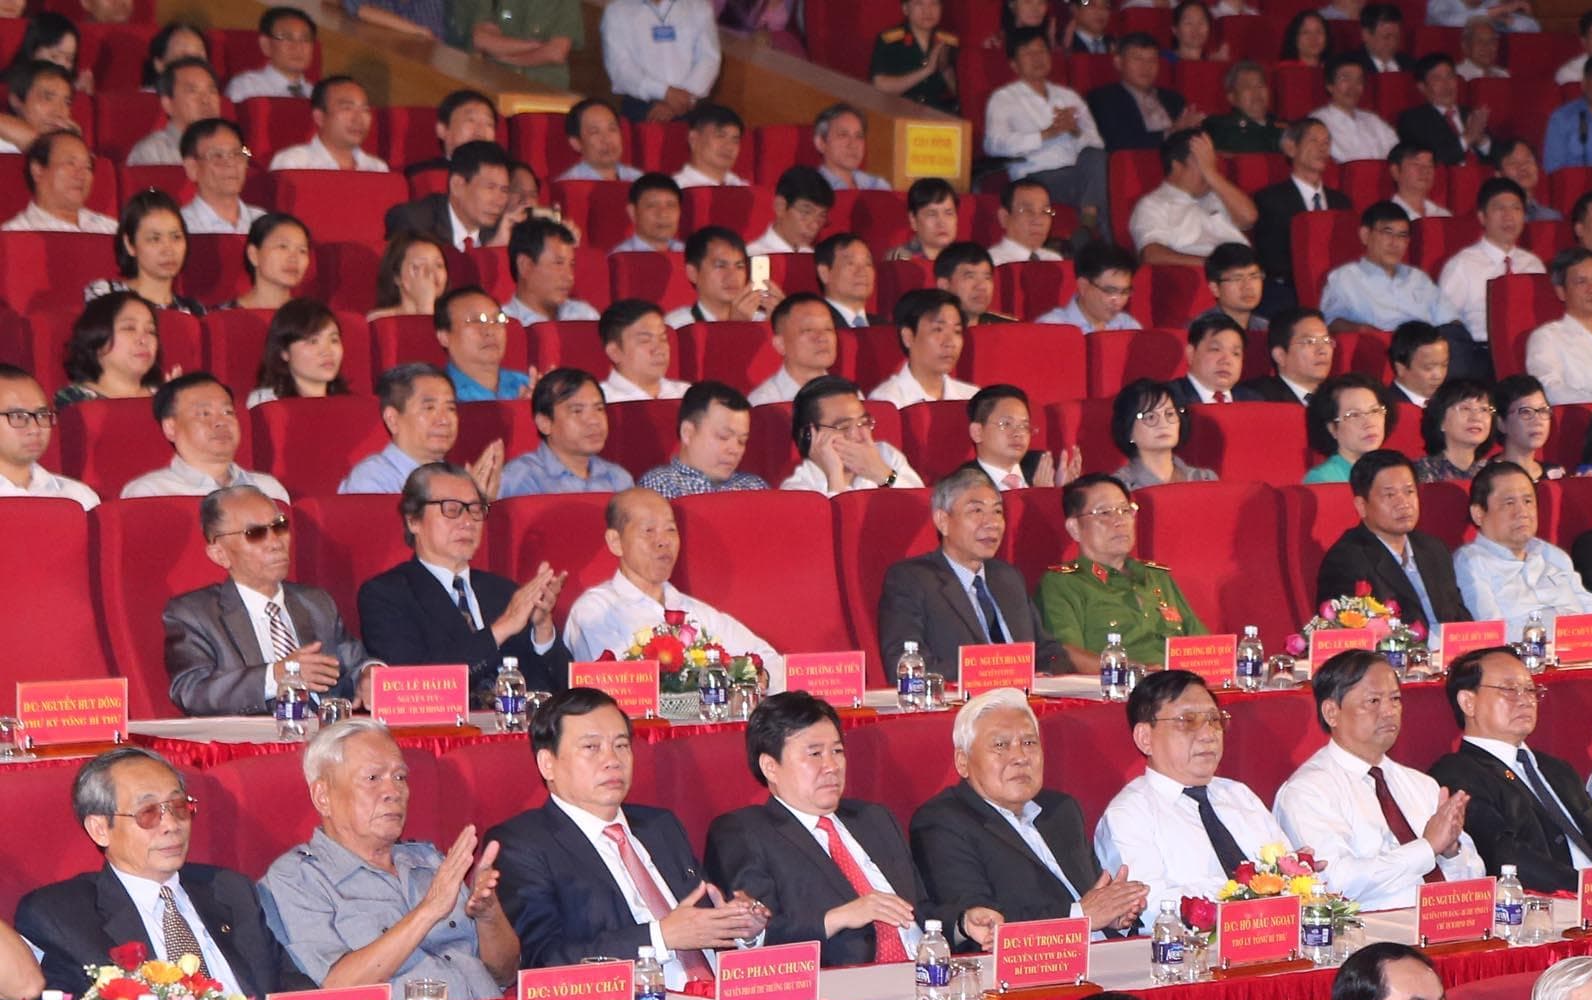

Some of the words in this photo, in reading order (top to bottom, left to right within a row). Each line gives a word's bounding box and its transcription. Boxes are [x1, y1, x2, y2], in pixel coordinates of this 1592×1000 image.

[1065, 932, 1081, 943] KIM
[746, 963, 775, 977] PHAN
[777, 959, 815, 974] CHUNG
[570, 981, 592, 996] DUY
